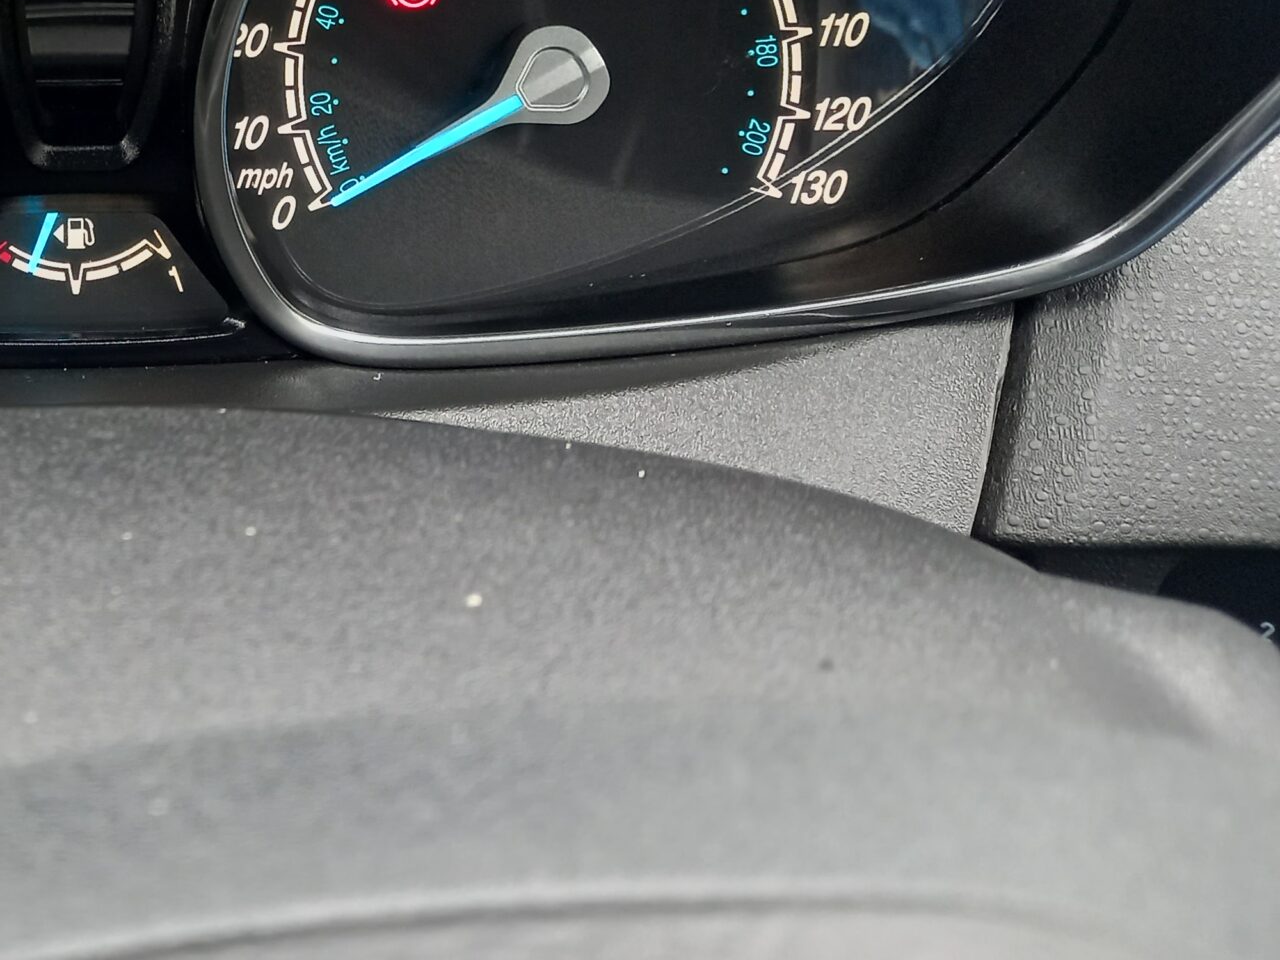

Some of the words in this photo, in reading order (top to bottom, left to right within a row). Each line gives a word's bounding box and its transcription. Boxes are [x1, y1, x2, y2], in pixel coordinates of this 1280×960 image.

[315, 5, 339, 30] 40
[819, 12, 869, 48] 110
[754, 35, 778, 67] 180
[310, 92, 332, 116] 20
[814, 96, 872, 131] 120
[234, 115, 269, 151] 10
[317, 124, 350, 175] km/h
[742, 118, 770, 156] 200
[237, 162, 294, 195] mph
[789, 170, 848, 205] 130
[272, 195, 297, 230] 0
[168, 265, 184, 293] 1
